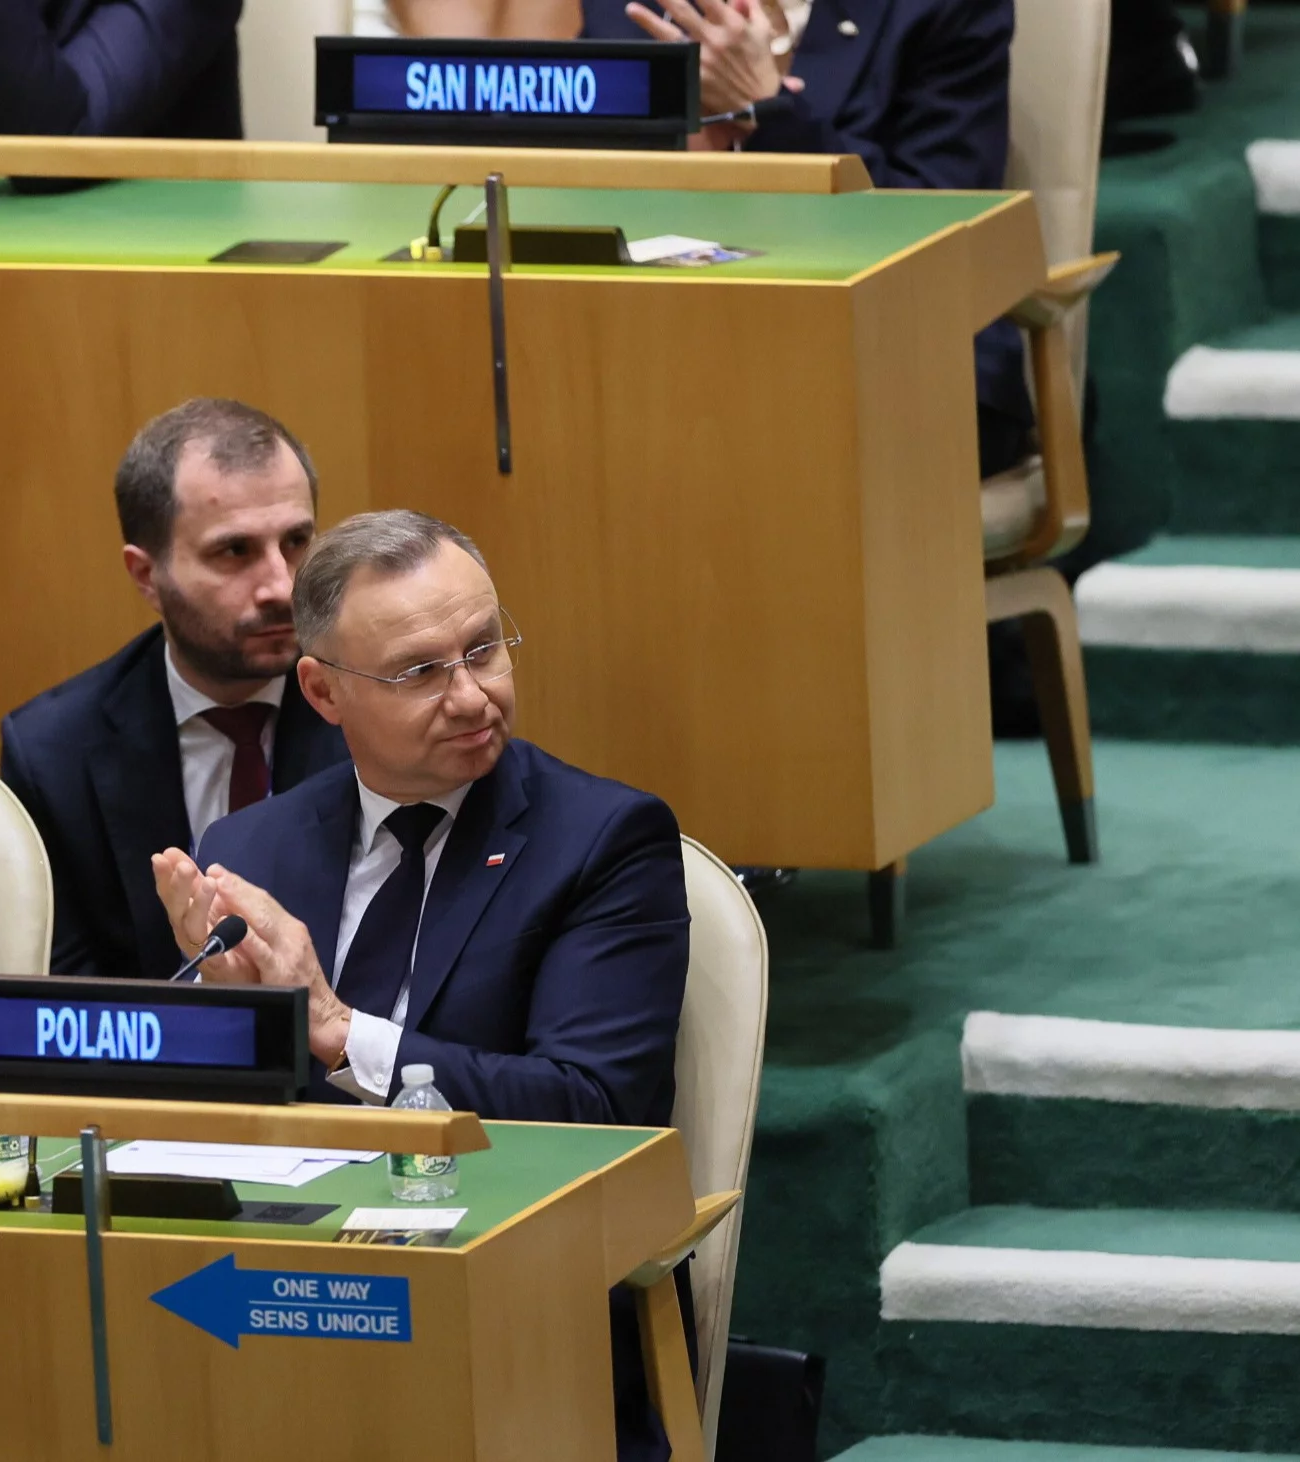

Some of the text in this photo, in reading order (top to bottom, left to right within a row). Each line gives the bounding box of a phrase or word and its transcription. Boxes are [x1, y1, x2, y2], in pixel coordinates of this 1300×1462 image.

[406, 62, 597, 113] SAN MARINO
[36, 1006, 162, 1060] POLAND
[272, 1278, 372, 1301] ONE WAY
[249, 1308, 400, 1335] SENS UNIQUE
